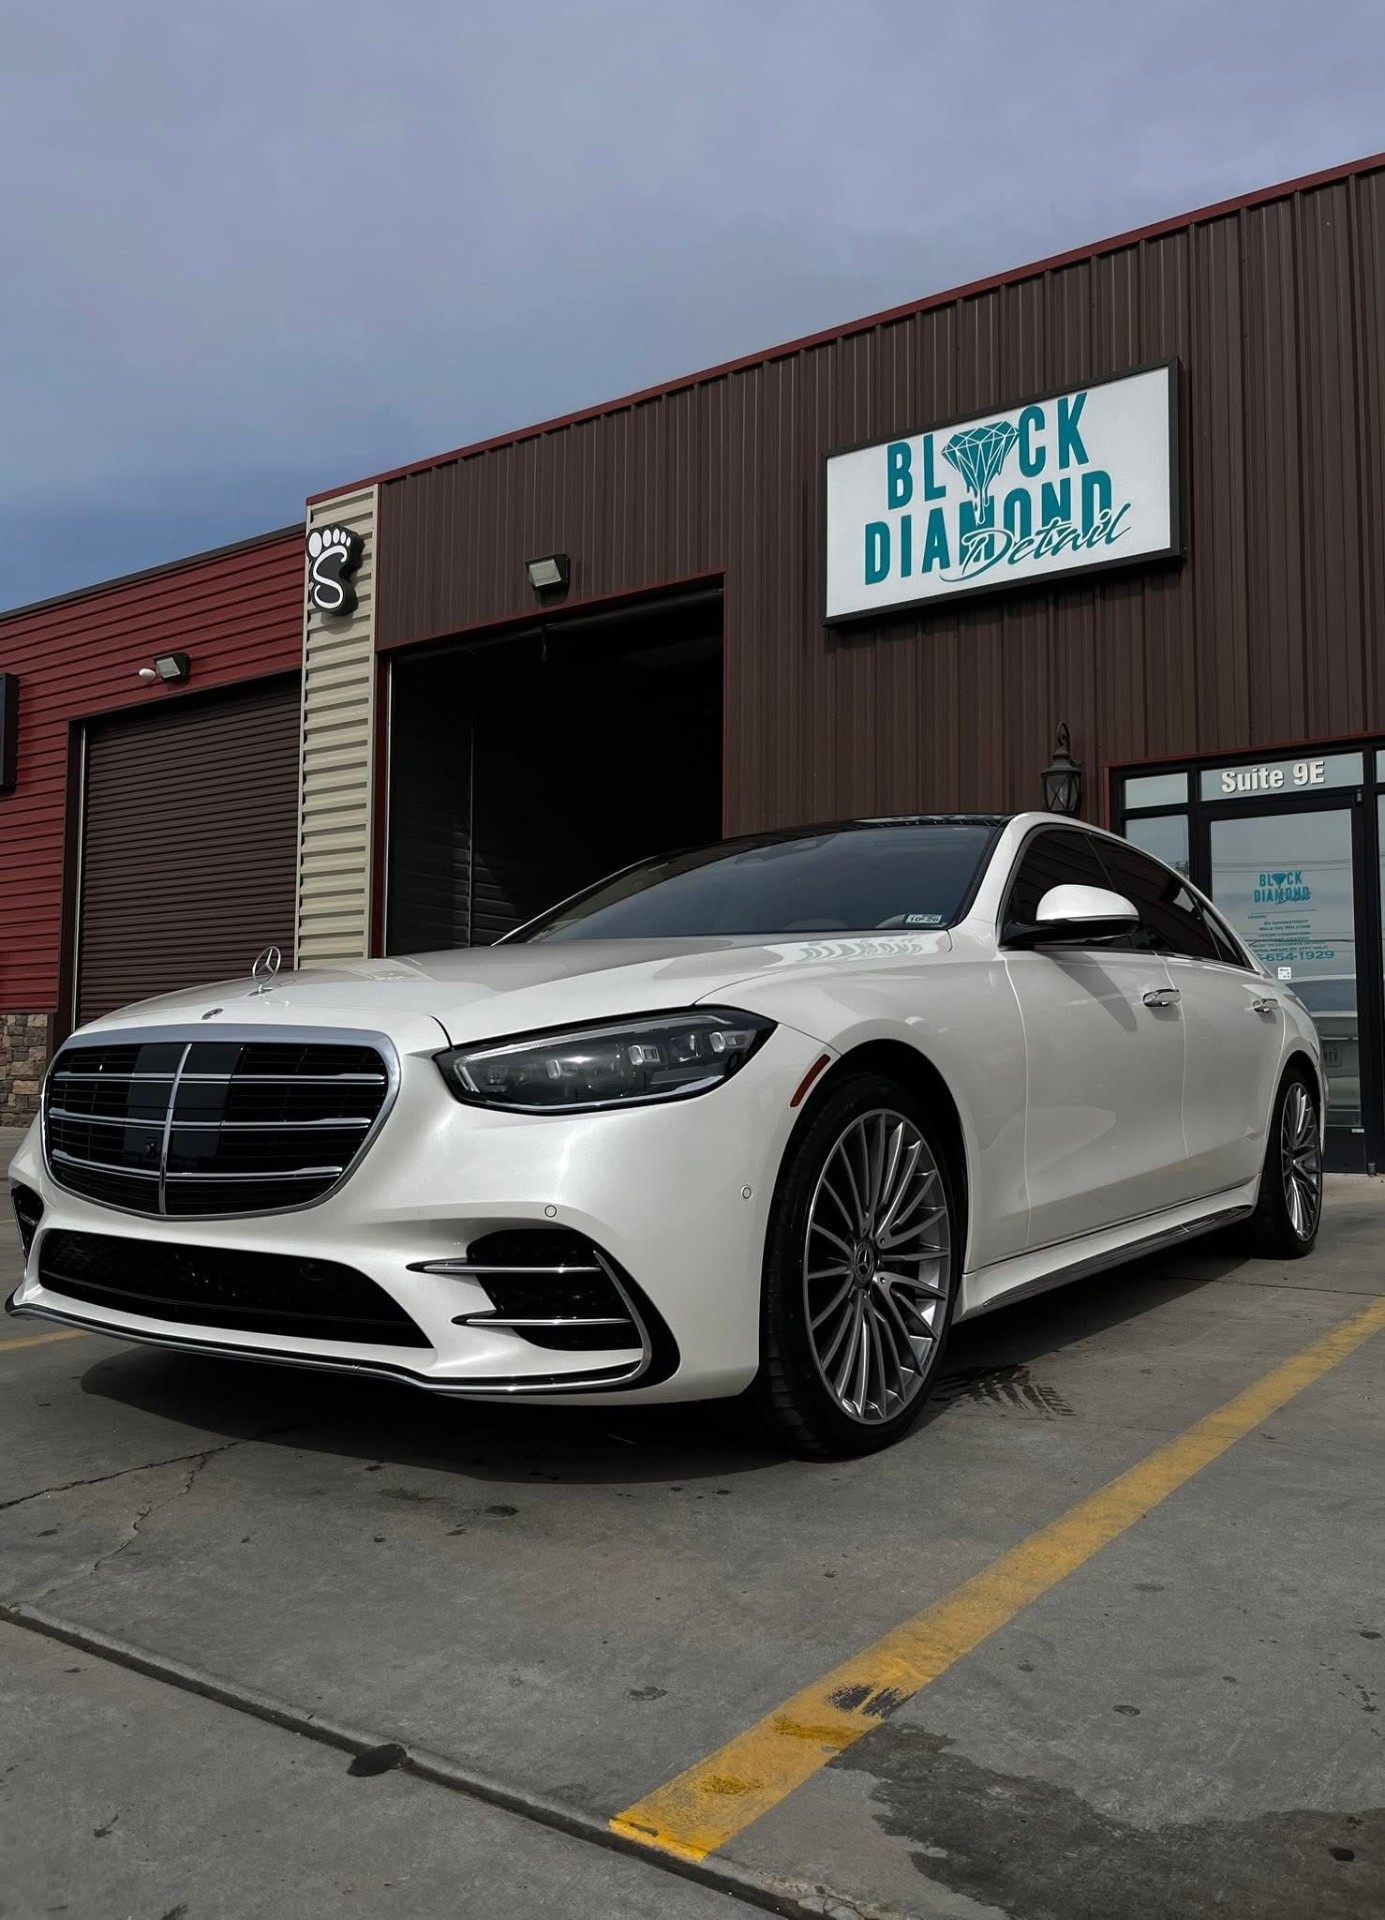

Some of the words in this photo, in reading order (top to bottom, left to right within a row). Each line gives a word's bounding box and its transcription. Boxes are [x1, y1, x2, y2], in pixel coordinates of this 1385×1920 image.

[887, 391, 1090, 511] BLCK
[864, 470, 1113, 586] DIAMOND
[938, 503, 1132, 583] Detail
[1221, 767, 1285, 793] Suite
[1292, 760, 1325, 786] 9E
[1253, 886, 1311, 903] DIAMOND
[1259, 871, 1302, 887] BLCK
